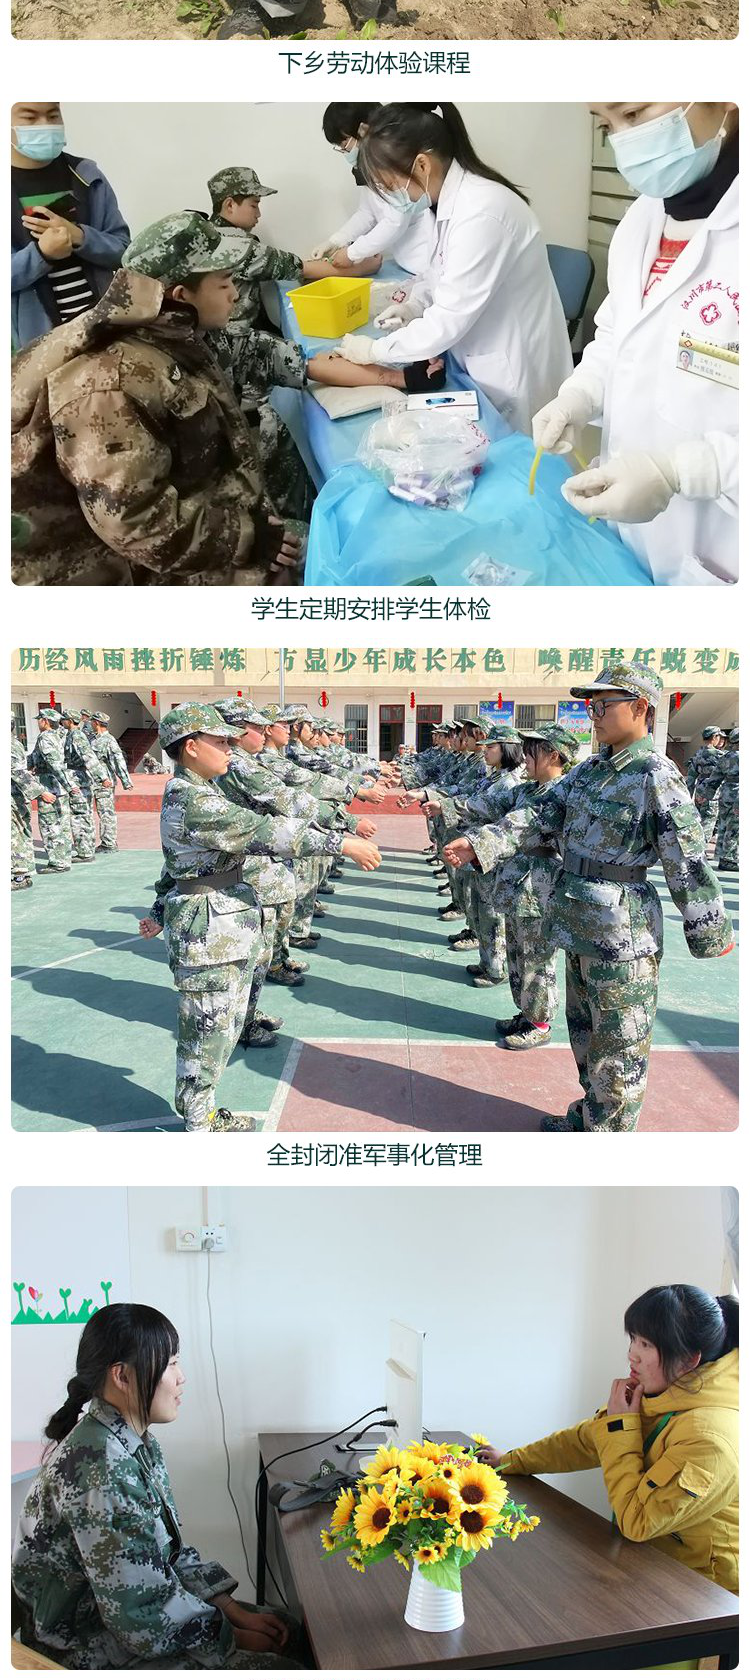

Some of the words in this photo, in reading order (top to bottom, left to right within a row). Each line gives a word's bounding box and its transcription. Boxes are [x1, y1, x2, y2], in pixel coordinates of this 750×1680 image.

[18, 648, 247, 672] 历经风雨挫折锤炼
[275, 648, 508, 673] 方显少年成长本色
